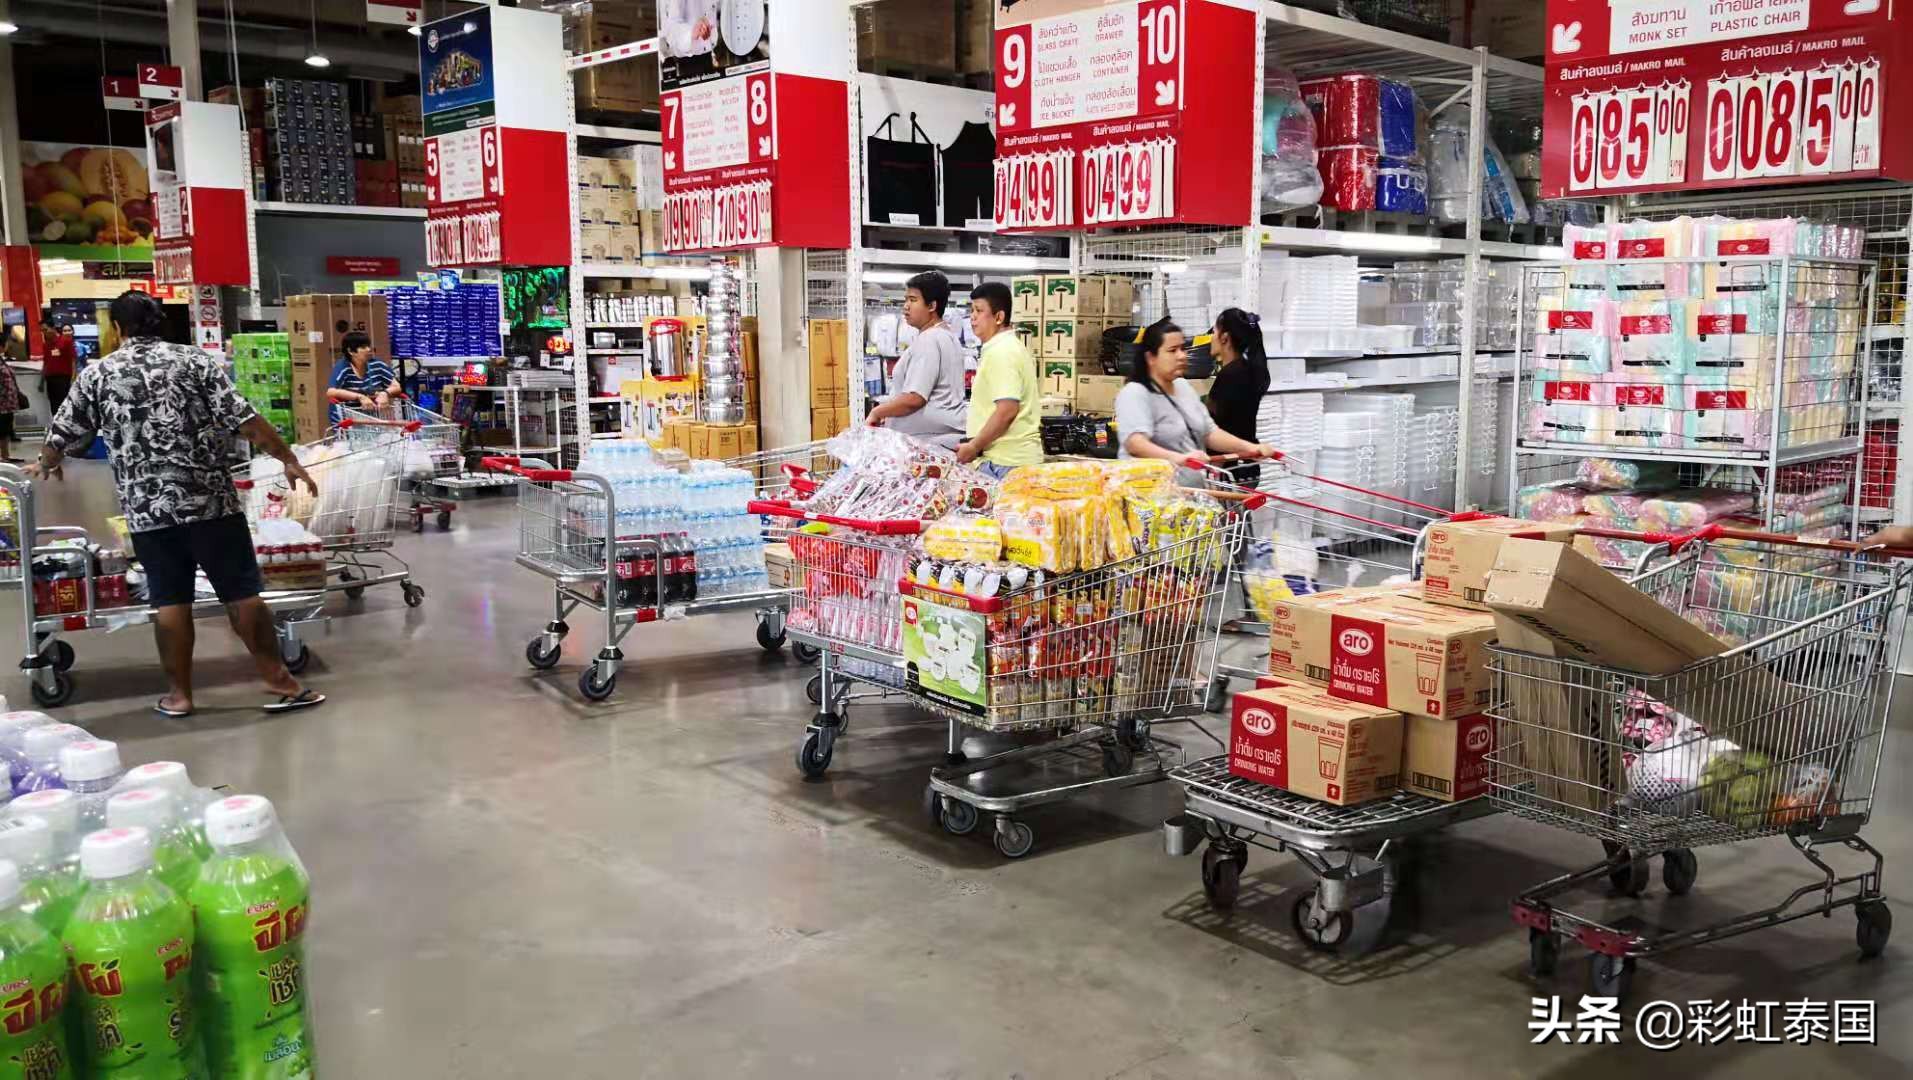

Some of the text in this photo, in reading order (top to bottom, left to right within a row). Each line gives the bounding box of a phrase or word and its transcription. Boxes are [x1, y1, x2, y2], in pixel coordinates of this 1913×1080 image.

[1710, 11, 1801, 33] PLASTIC CHAIR
[1095, 30, 1124, 41] DRAWER
[1141, 5, 1176, 65] 10
[1628, 26, 1688, 44] MONK SET
[1802, 40, 1838, 52] MAKRO
[1842, 35, 1866, 47] MAIL
[1003, 34, 1026, 88] 9
[1630, 61, 1661, 72] MAKRO
[1664, 58, 1686, 68] MAIL
[145, 67, 158, 83] 2
[110, 80, 119, 94] 1
[750, 80, 767, 125] 8
[663, 97, 679, 139] 7
[483, 131, 496, 168] 6
[427, 142, 438, 177] 5
[1343, 633, 1369, 650] aro
[1333, 678, 1374, 696] DRINKING WATER
[1246, 711, 1272, 731] aro
[1469, 730, 1488, 745] aro
[1234, 757, 1275, 777] DRINKING WATER
